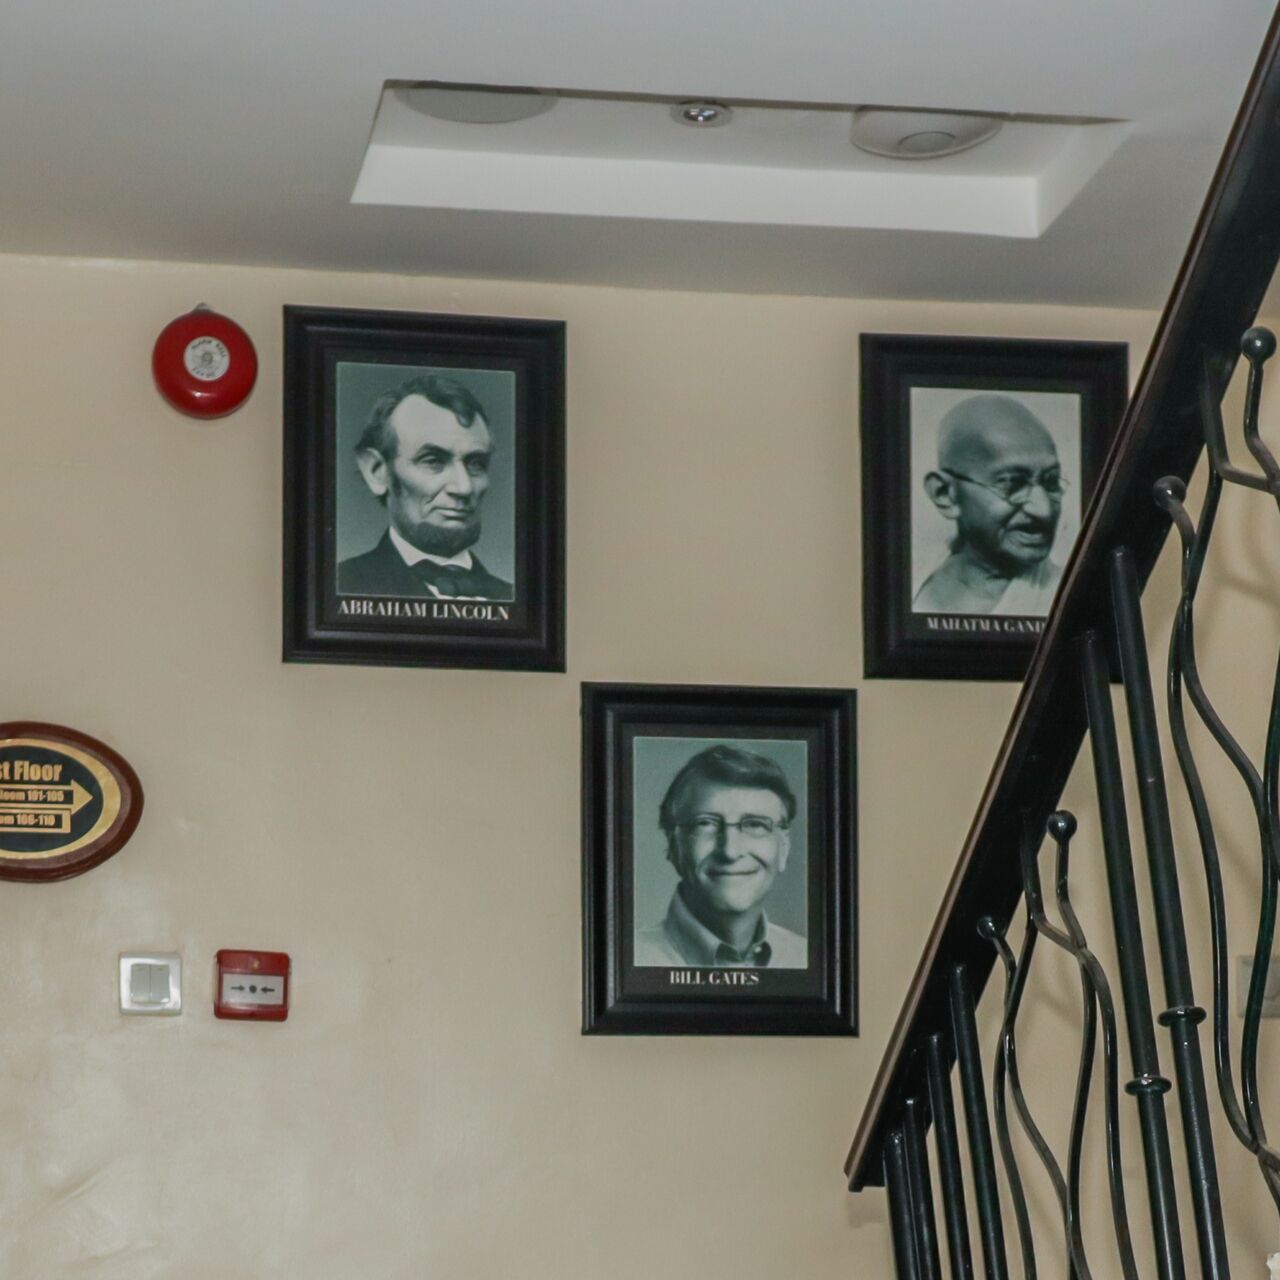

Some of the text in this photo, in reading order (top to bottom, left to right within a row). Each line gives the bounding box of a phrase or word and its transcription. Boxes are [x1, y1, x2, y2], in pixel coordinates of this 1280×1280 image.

[337, 599, 510, 621] ABRAHAM LINCOLN
[926, 616, 1001, 632] MAHATMA
[14, 760, 63, 782] Floor
[670, 970, 760, 986] BILL GATES
